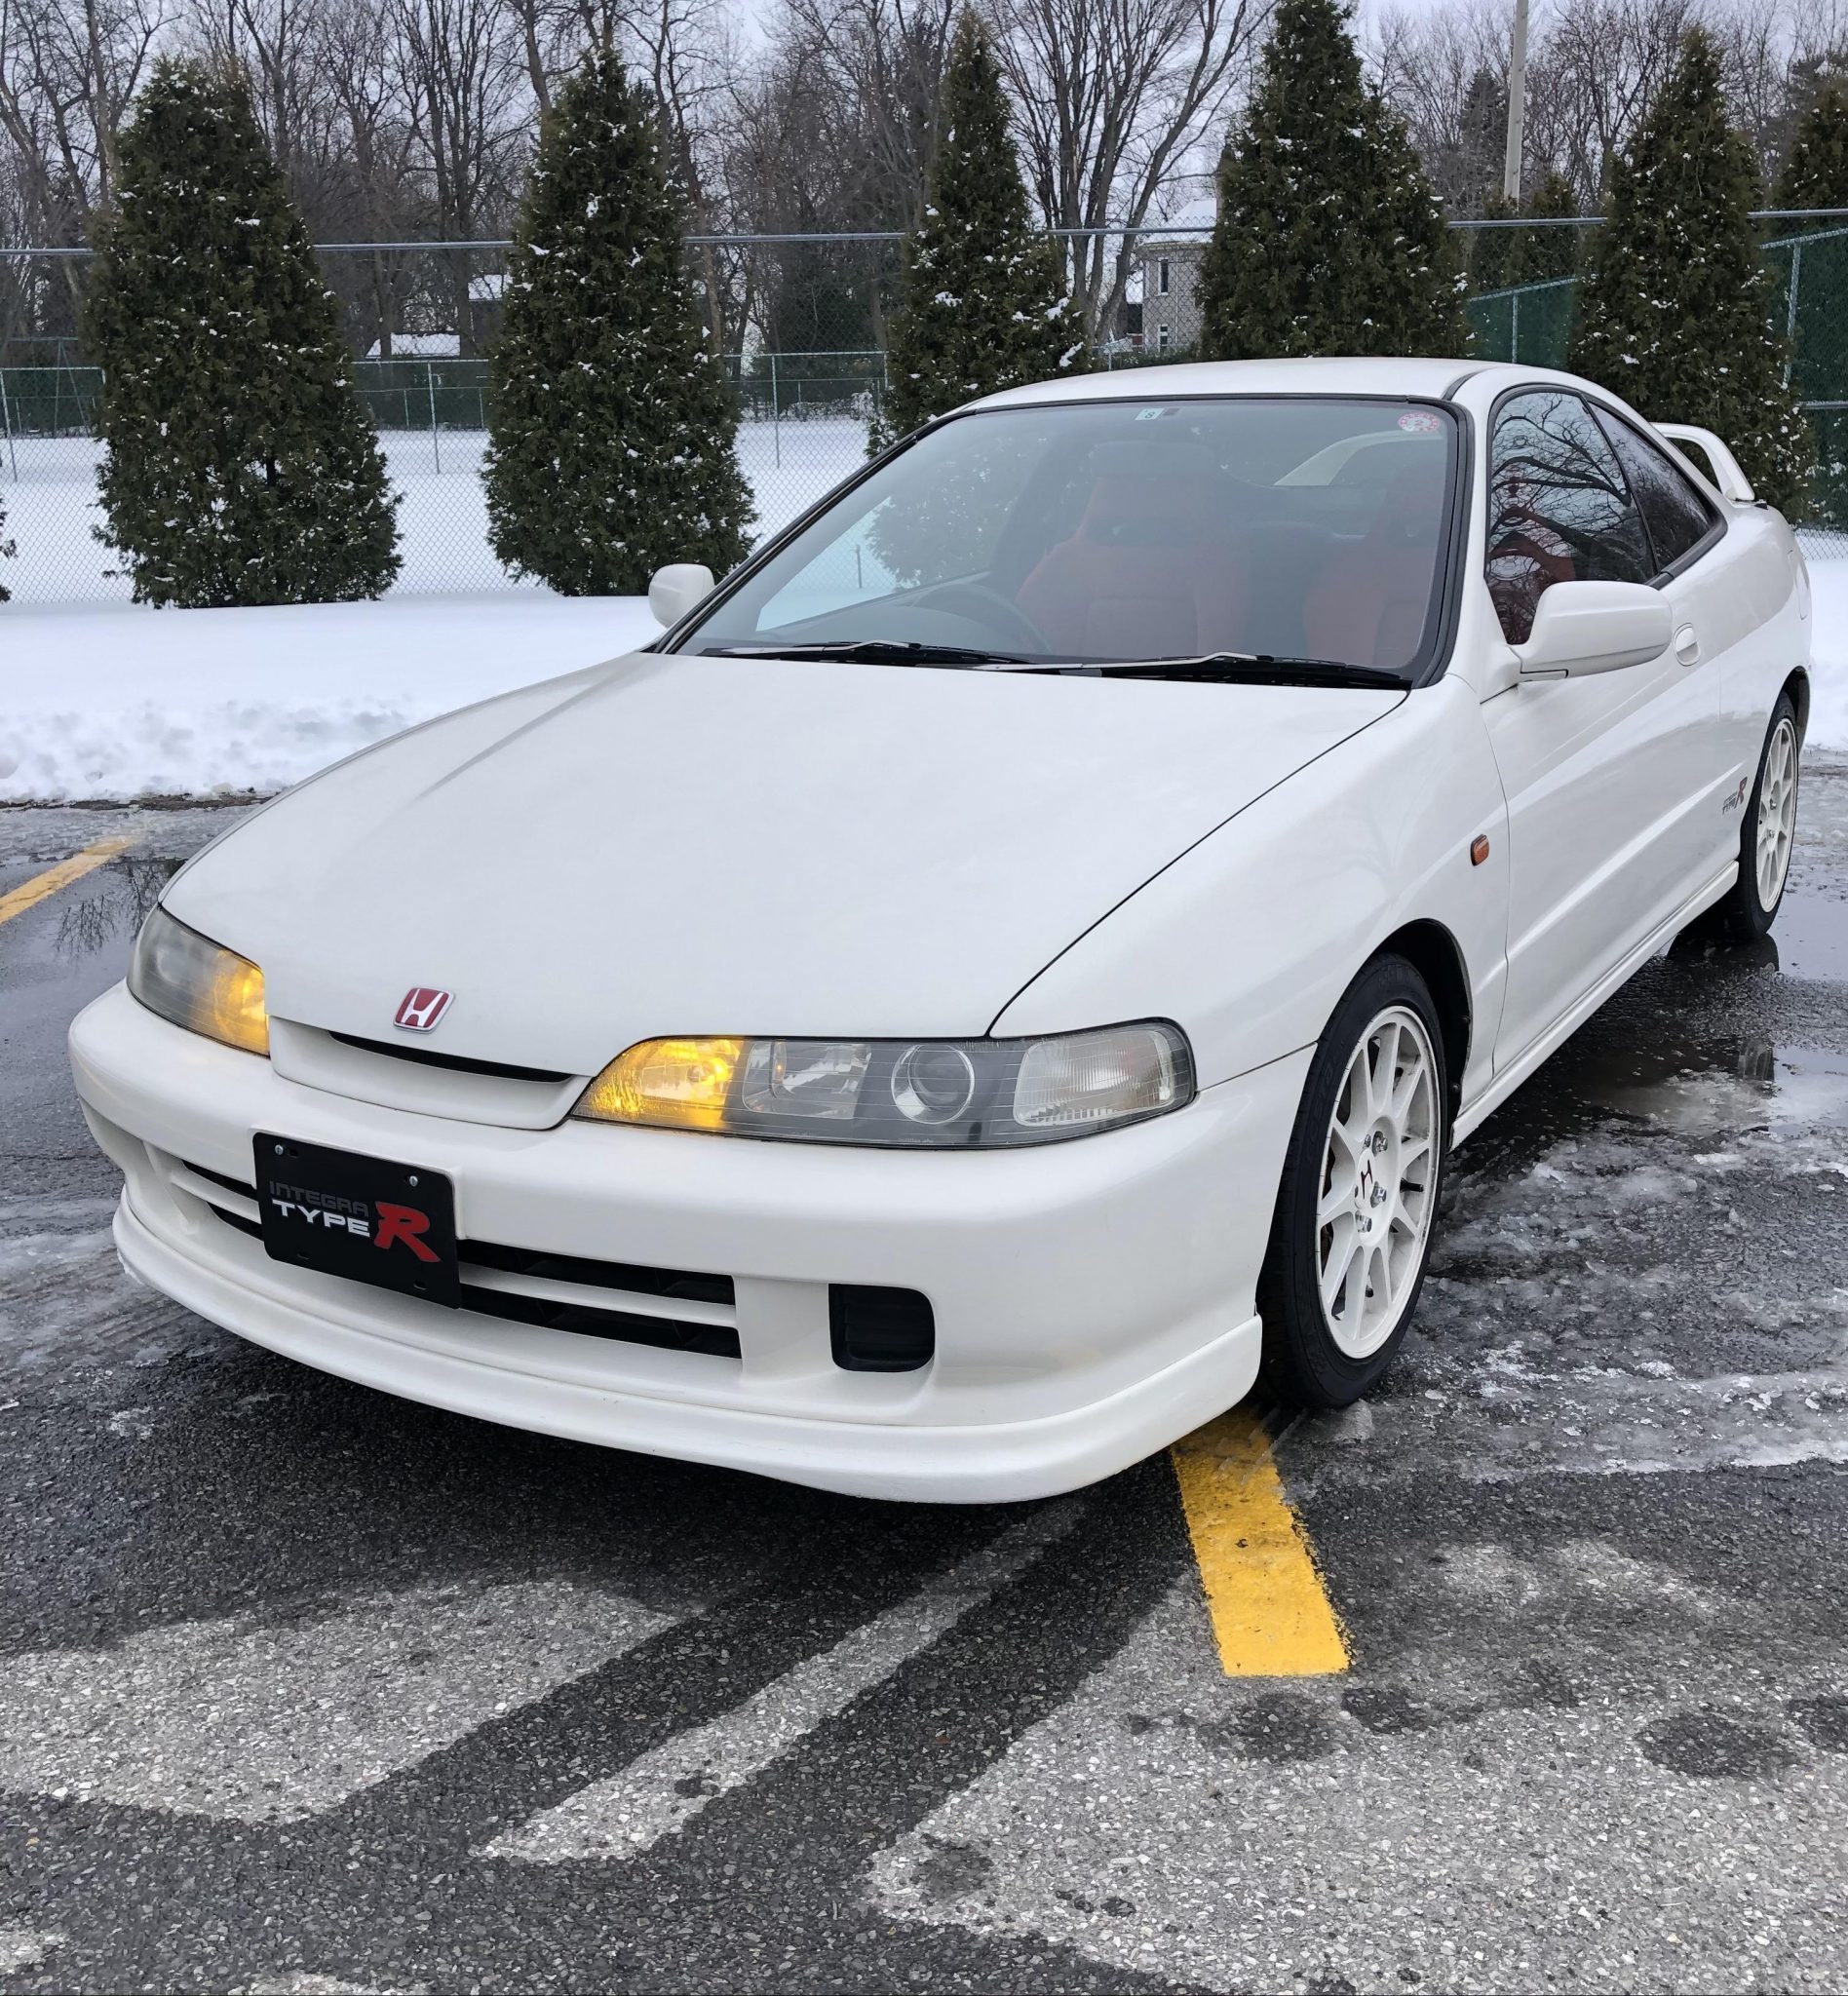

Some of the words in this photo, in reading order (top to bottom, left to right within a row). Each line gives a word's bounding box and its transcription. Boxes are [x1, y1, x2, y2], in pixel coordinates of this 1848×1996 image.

[1734, 776, 1748, 809] R
[269, 1180, 369, 1218] INTEGRA
[272, 1199, 370, 1238] TYPE
[373, 1201, 442, 1263] R
